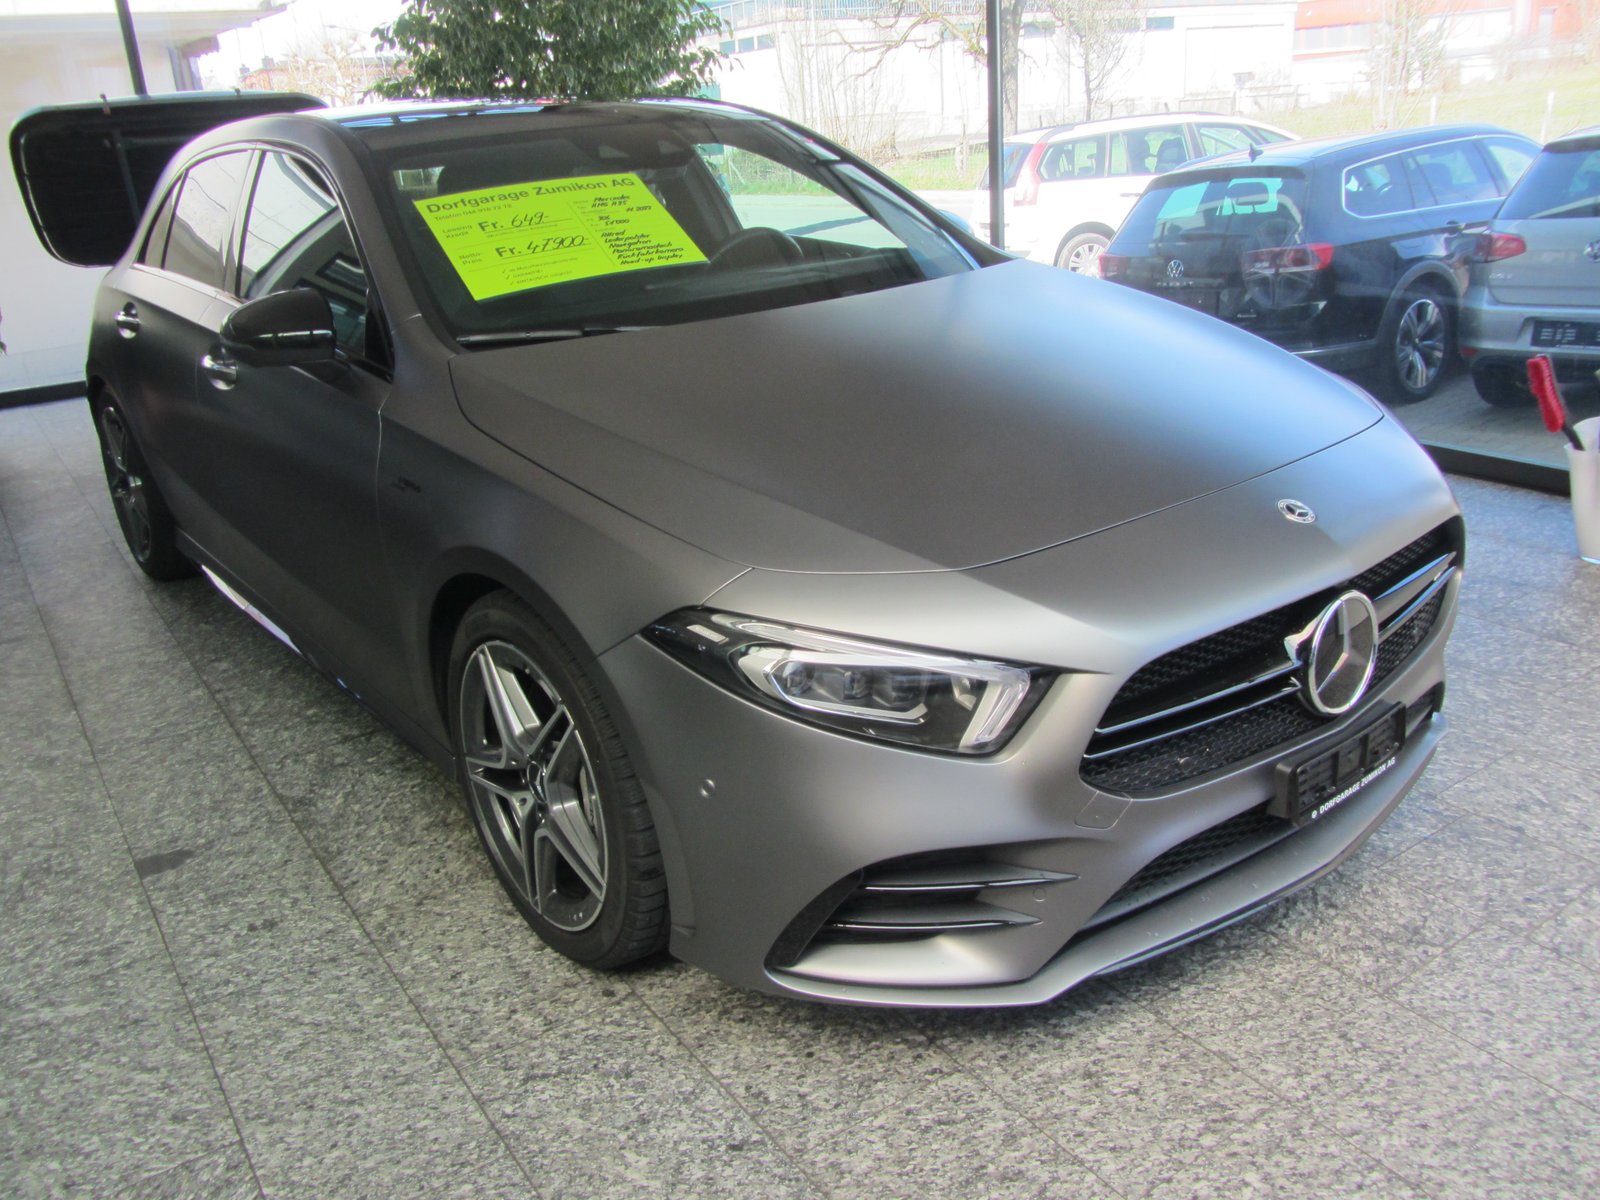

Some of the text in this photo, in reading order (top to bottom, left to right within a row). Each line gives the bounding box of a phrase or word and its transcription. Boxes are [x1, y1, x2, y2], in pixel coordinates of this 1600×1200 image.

[426, 178, 635, 214] Dorfgarage Zumikon AG
[478, 220, 504, 232] Fr.
[495, 246, 522, 258] Fr.
[1319, 756, 1396, 815] DORFGARAGE ZUMIKON AG
